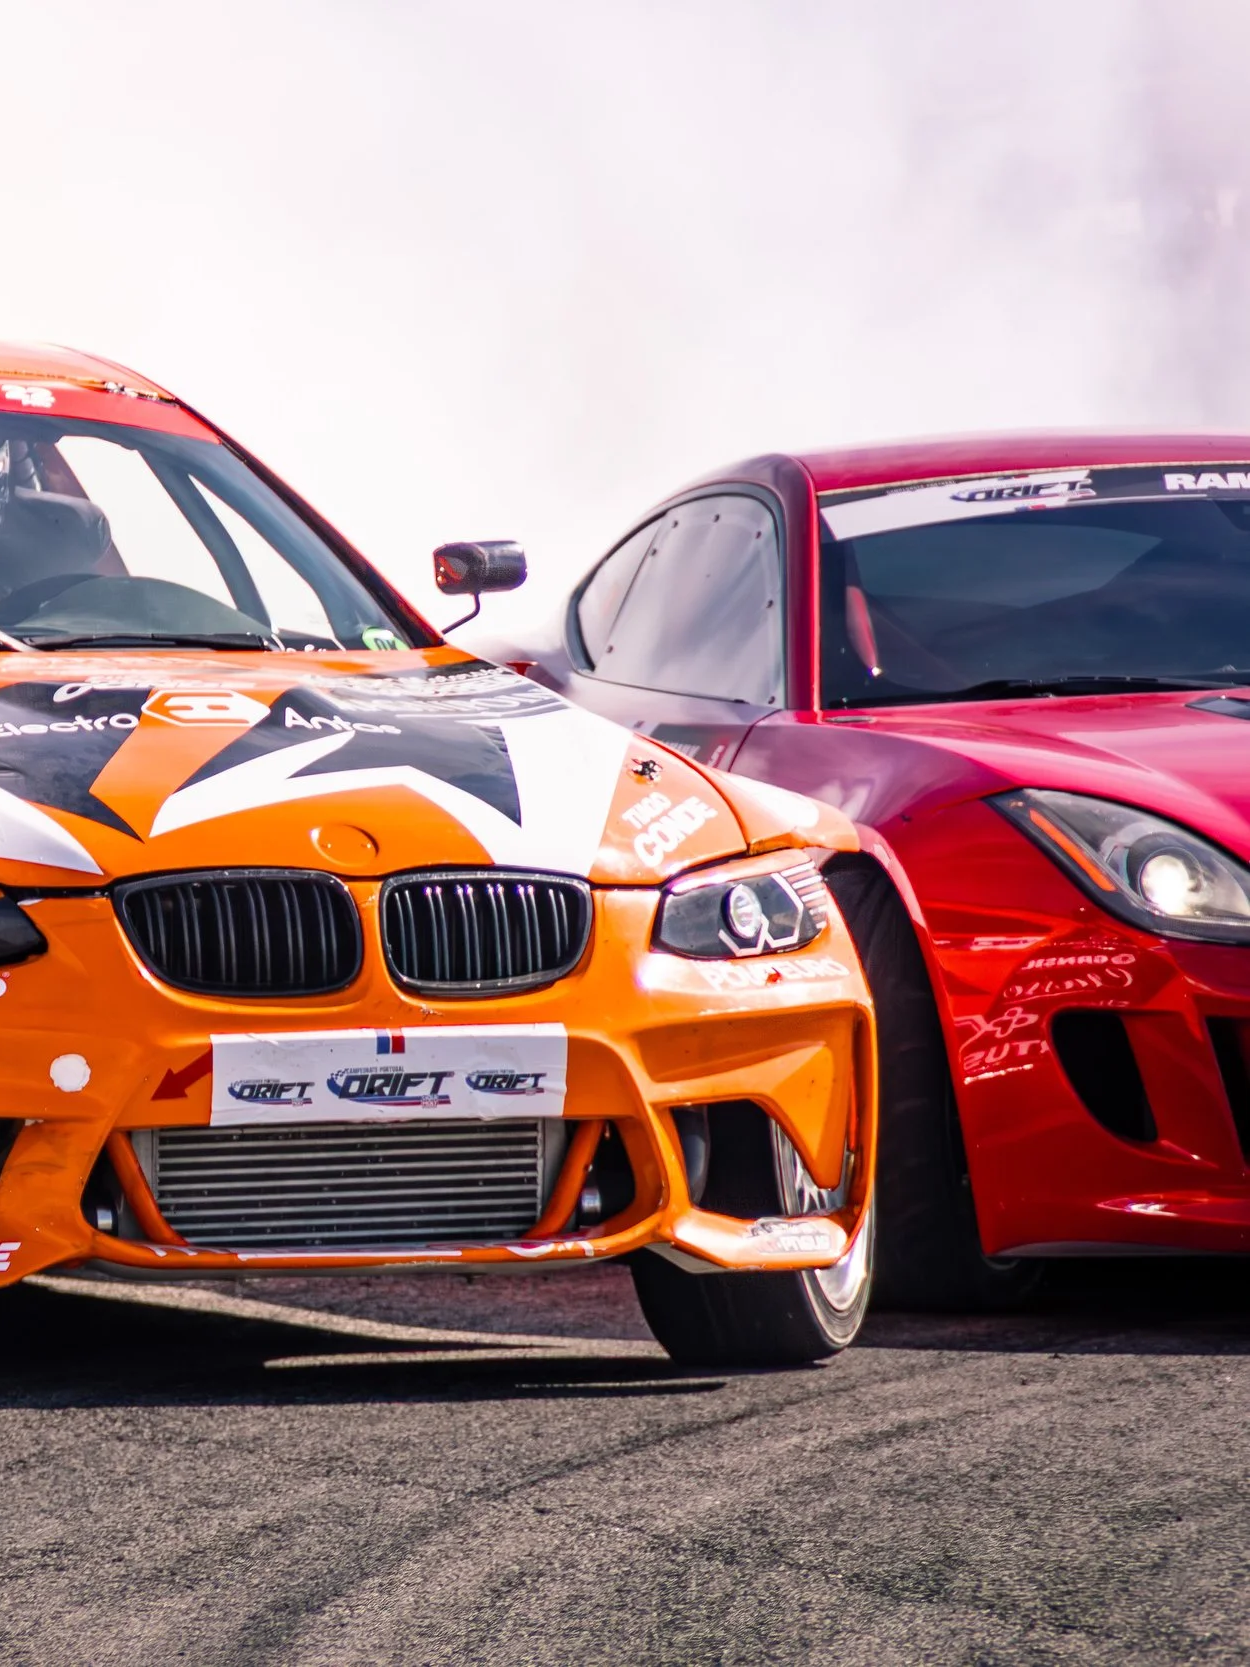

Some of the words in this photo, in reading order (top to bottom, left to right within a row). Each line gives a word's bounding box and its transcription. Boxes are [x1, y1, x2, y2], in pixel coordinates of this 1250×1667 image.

[283, 706, 402, 735] Antos
[634, 796, 718, 867] CONDE
[236, 1081, 315, 1100] DRIFT
[338, 1071, 455, 1099] DRIFT
[473, 1072, 547, 1090] DRIFT
